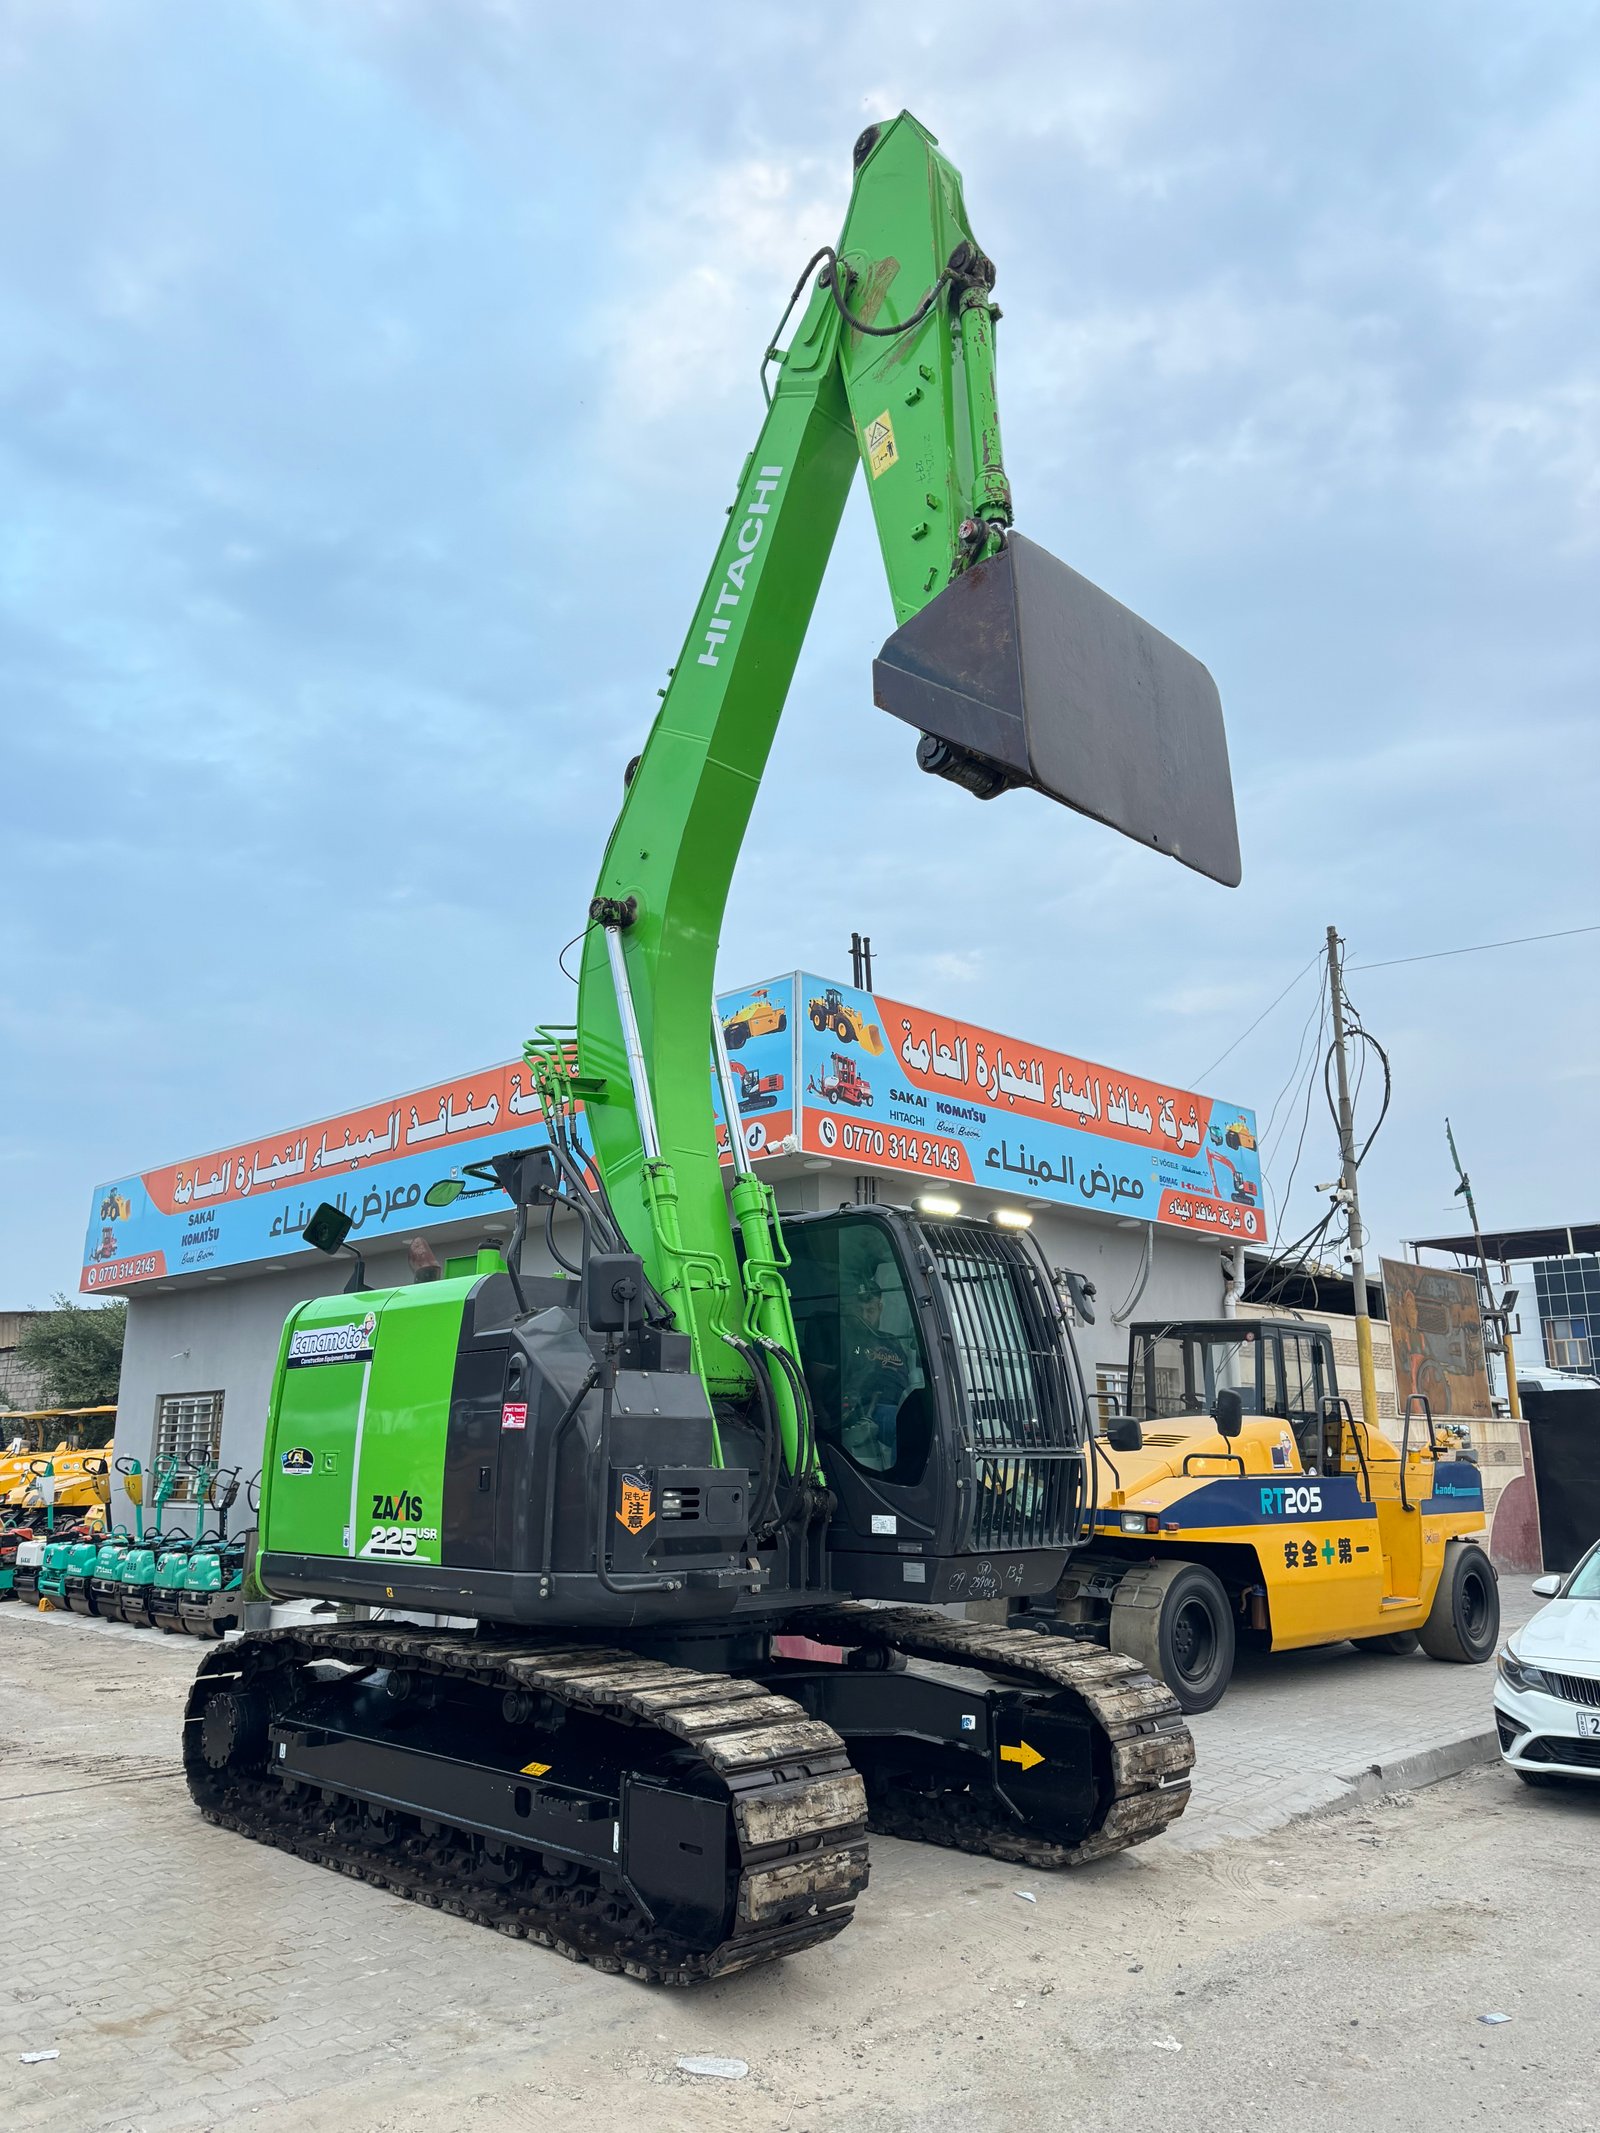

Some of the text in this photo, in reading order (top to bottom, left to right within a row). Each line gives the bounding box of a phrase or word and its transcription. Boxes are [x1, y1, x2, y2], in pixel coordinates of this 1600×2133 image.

[698, 466, 783, 666] HITACHI
[889, 1088, 927, 1108] SAKAI
[901, 1018, 1201, 1150] شركة منافذ الميناء للتجارة العامة
[406, 1091, 500, 1145] منافذ
[889, 1110, 925, 1127] HITACHI
[936, 1101, 986, 1124] KOMATSU
[310, 1109, 401, 1172] الميناء
[842, 1123, 960, 1171] 0770 314 2143
[174, 1158, 232, 1205] العامة
[235, 1137, 308, 1196] للتجارة
[984, 1140, 1144, 1203] معرض الميناء
[188, 1209, 215, 1226] SAKAI
[351, 1183, 421, 1230] معرض
[181, 1227, 220, 1247] KOMATSU
[98, 1257, 156, 1282] 0770 314 2143
[300, 1353, 357, 1365] Construction Equipment Rental
[372, 1490, 423, 1521] ZAXIS
[623, 1491, 649, 1501] 足もと
[1260, 1486, 1323, 1515] RT205
[627, 1501, 645, 1528] 注意
[1284, 1537, 1370, 1569] 安全 第一
